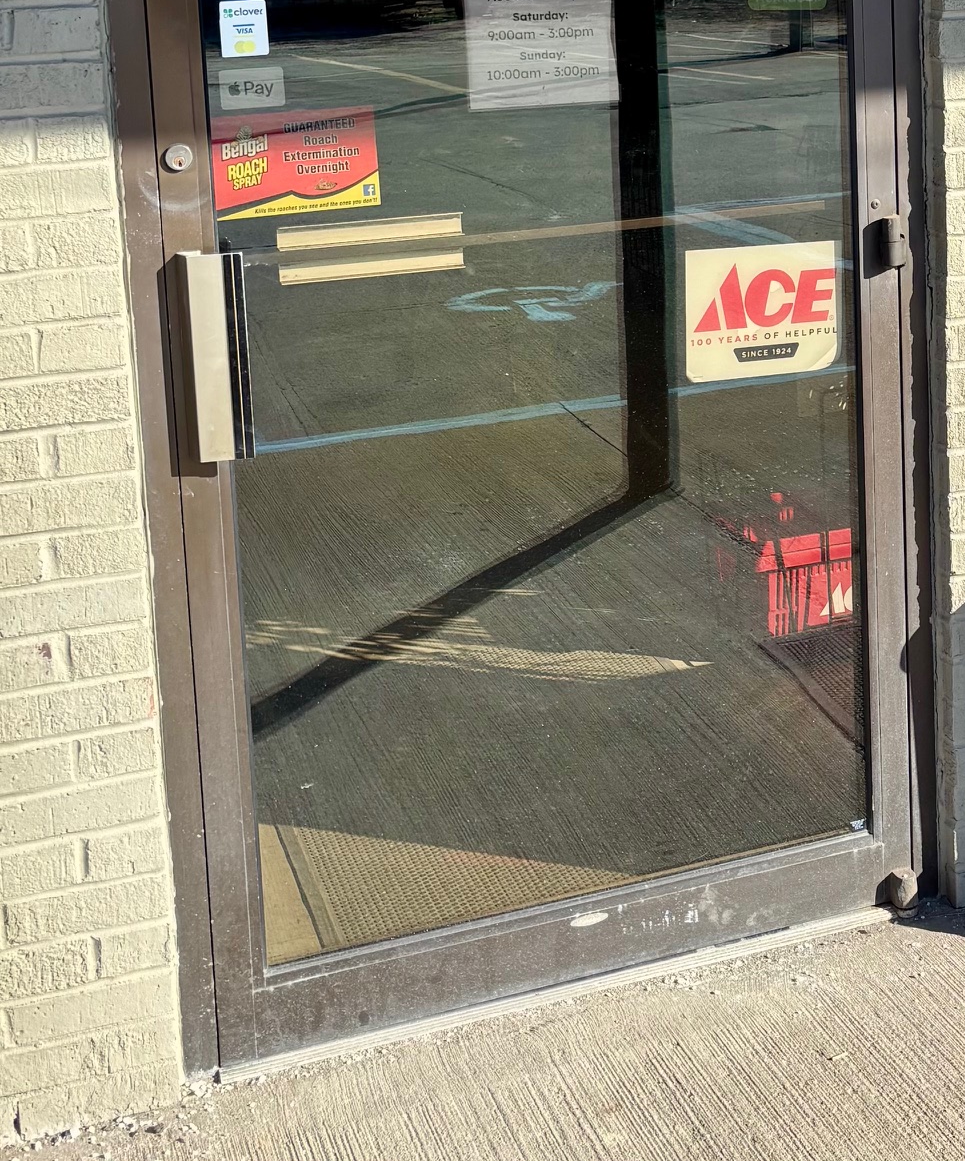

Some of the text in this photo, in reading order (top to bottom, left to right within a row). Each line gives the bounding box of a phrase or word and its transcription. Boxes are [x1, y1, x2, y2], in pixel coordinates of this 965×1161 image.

[233, 6, 263, 17] clover
[512, 11, 568, 22] Saturday:
[236, 27, 254, 35] VISA
[488, 30, 536, 42] 9:00am
[548, 27, 594, 39] 3:00pm
[519, 50, 566, 61] Sunday:
[487, 69, 541, 81] 10:00am
[554, 66, 600, 78] 3:00pm
[244, 81, 274, 98] Pay
[283, 117, 355, 134] GUARANTEED
[221, 134, 269, 161] Bengal
[303, 133, 338, 146] Roach
[283, 146, 360, 163] Extermination
[227, 156, 268, 181] ROACH
[296, 160, 350, 176] Overnight
[233, 174, 263, 190] SPRAY
[693, 263, 838, 333] ACE
[691, 326, 838, 347] 100 YEARS OF HELPFUL
[741, 347, 792, 358] SINCE 1924
